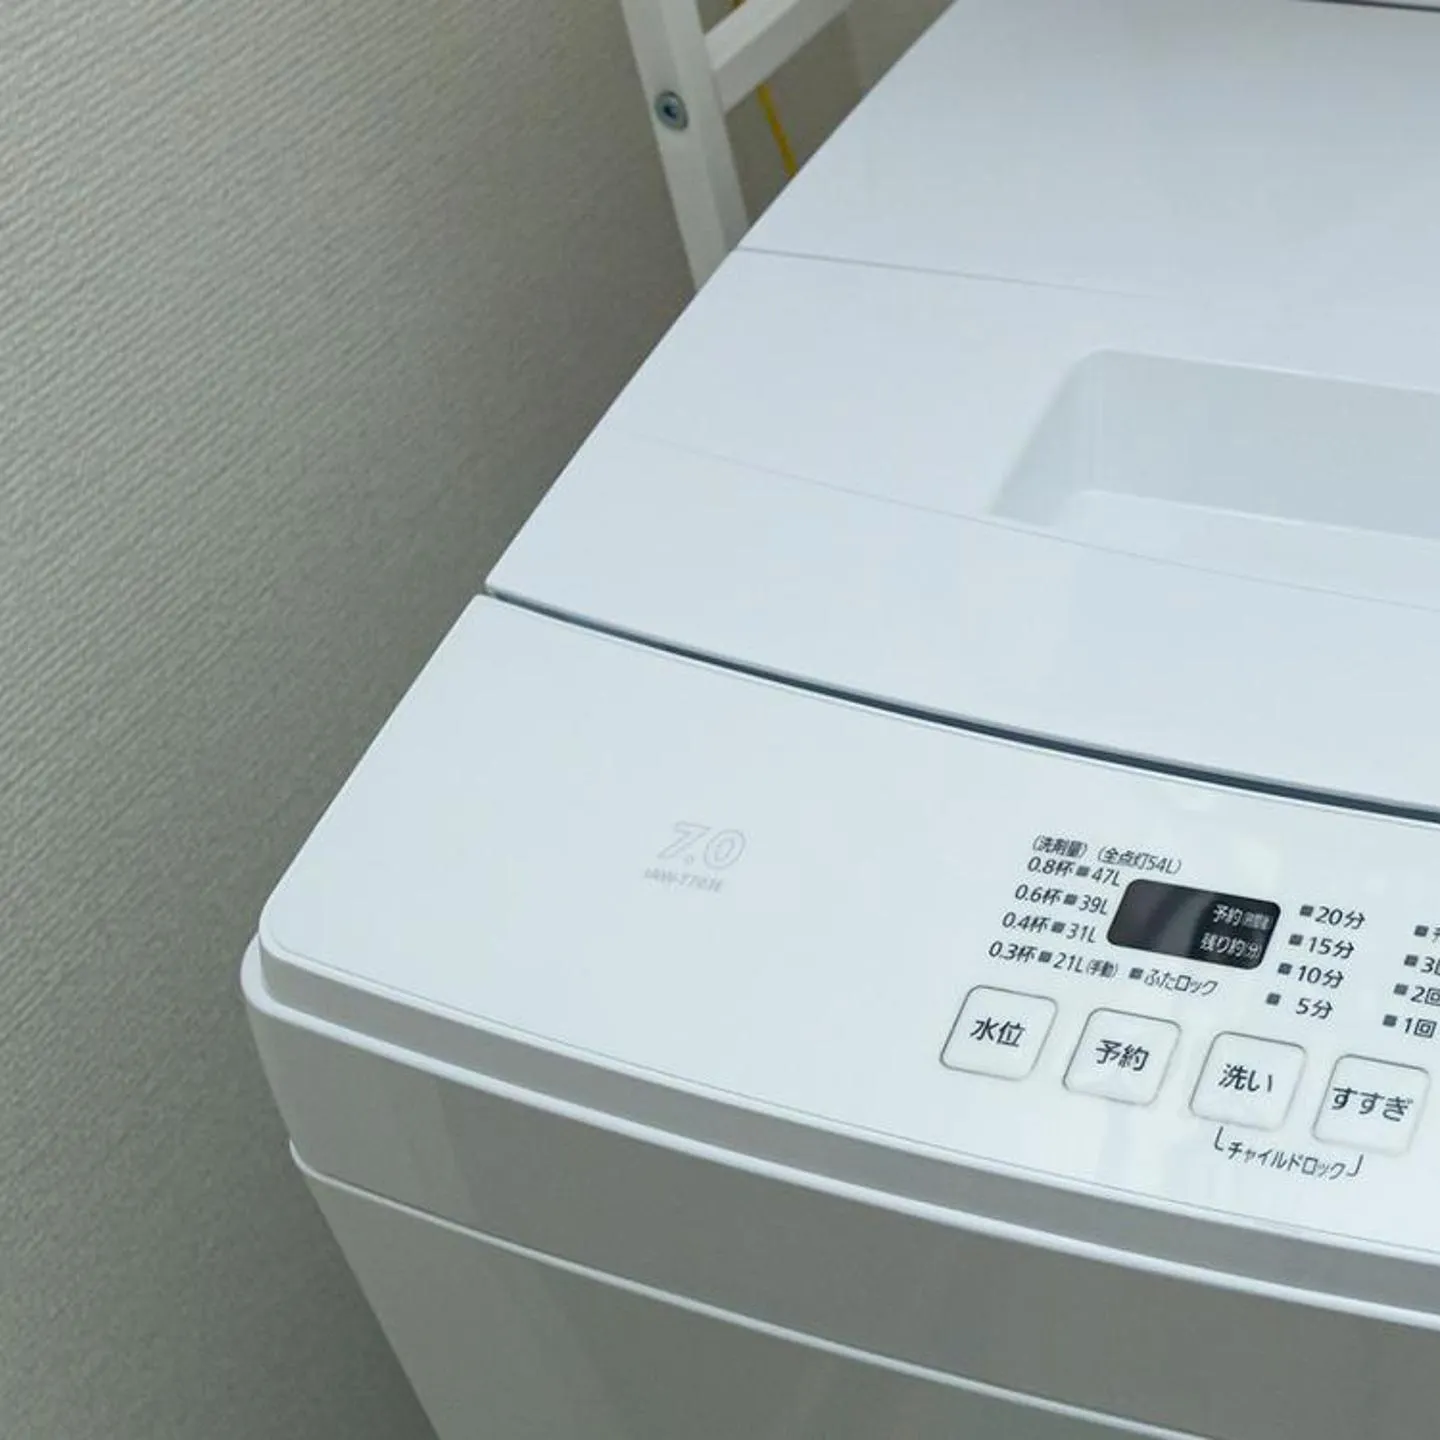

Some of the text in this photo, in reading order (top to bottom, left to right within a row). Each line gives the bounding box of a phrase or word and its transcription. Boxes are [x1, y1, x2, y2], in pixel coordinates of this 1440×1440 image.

[1091, 868, 1121, 887] 47L
[1078, 895, 1108, 915] 39L
[1315, 905, 1365, 930] 20分
[1065, 922, 1097, 943] 31L
[1307, 936, 1354, 960] 15分
[1144, 968, 1218, 995] ふたロック
[1296, 965, 1344, 989] 10分
[1295, 998, 1333, 1020] 5分
[970, 1018, 1025, 1048] 水位
[1403, 1017, 1437, 1039] 1回
[1095, 1039, 1149, 1073] 予約
[1217, 1063, 1273, 1094] 洗い
[1332, 1086, 1414, 1122] すすぎ
[1228, 1140, 1356, 1179] チャイルドロック
